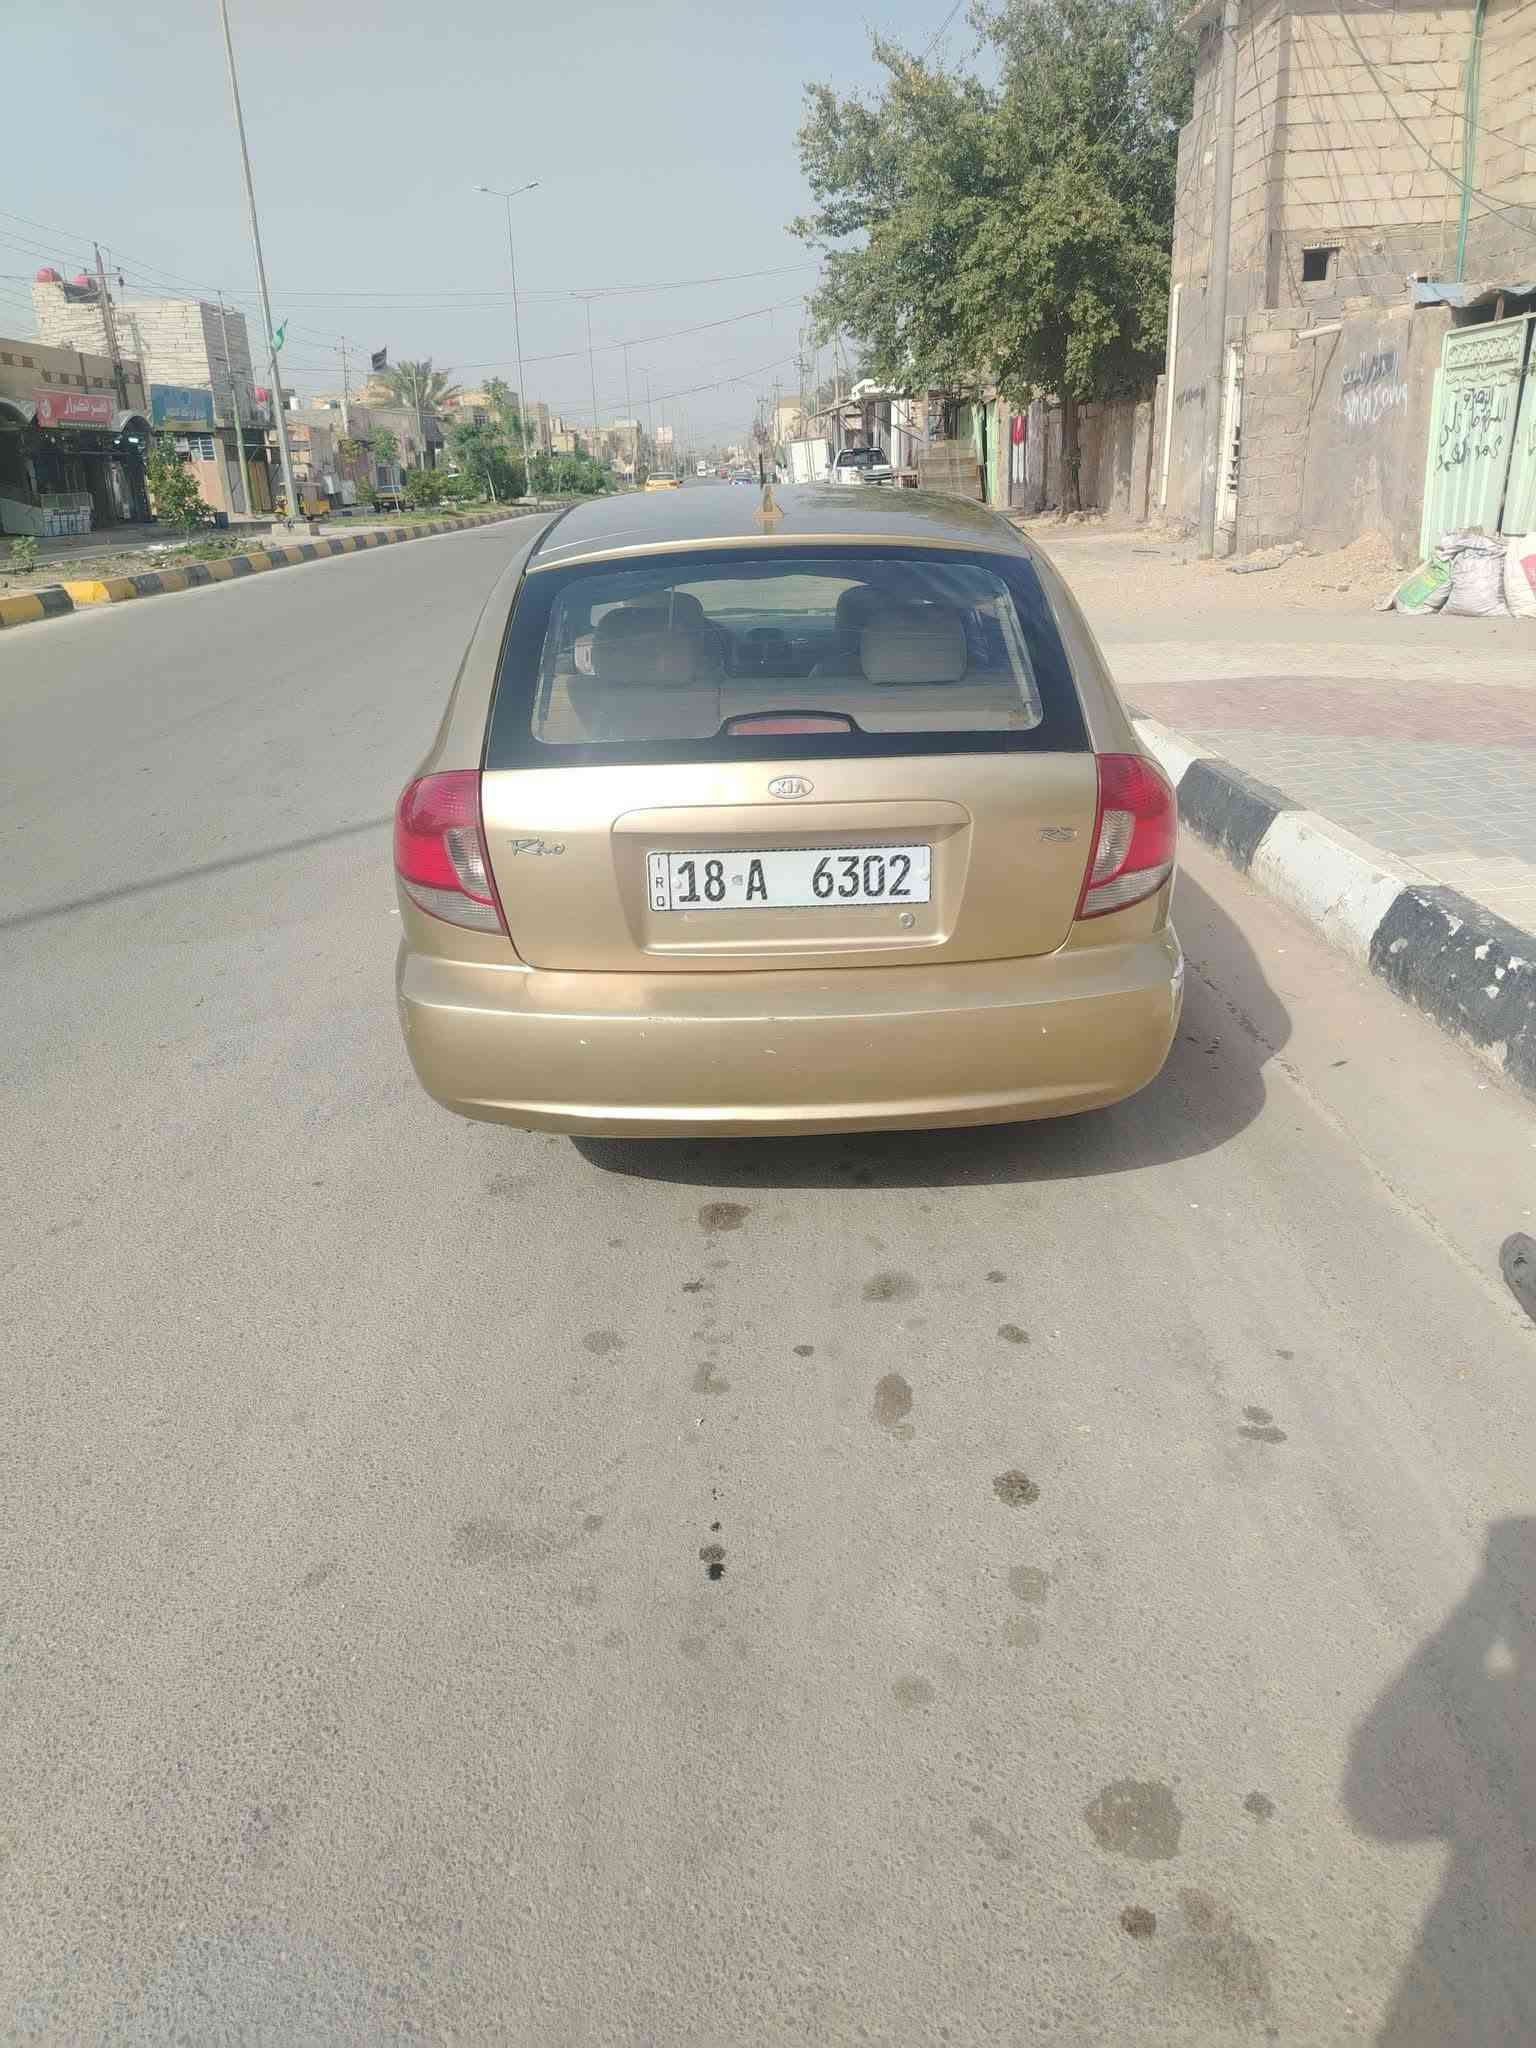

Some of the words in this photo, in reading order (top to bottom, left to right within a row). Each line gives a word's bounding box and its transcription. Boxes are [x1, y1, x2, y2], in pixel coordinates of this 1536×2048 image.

[775, 779, 808, 794] KIA
[511, 836, 566, 856] Rio
[677, 859, 727, 903] 18
[745, 858, 769, 901] A
[811, 853, 912, 899] 6302
